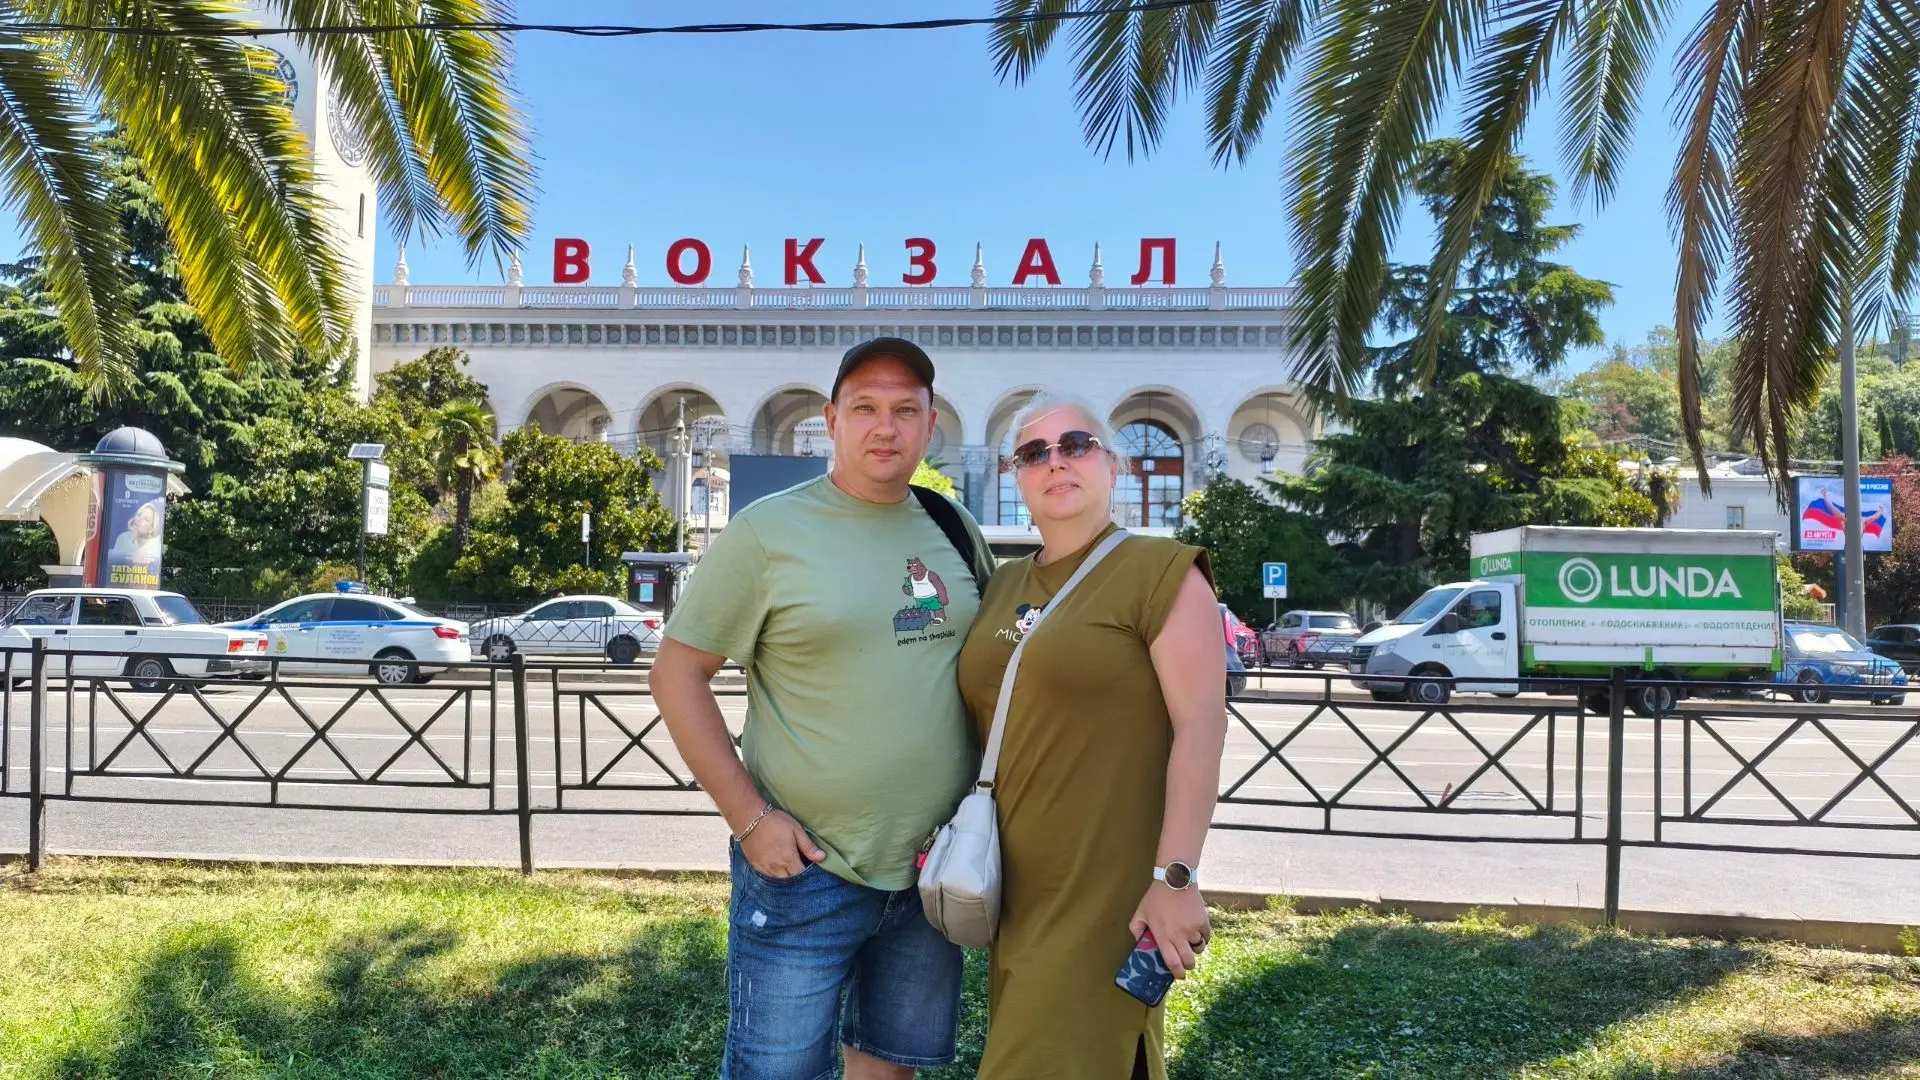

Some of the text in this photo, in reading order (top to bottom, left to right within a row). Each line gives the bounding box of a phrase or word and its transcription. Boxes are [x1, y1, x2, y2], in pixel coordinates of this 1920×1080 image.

[553, 237, 1176, 285] ВОКЗАЛ
[111, 564, 148, 574] ТАТЬЯНА
[1488, 558, 1513, 572] LUNDA
[1269, 565, 1282, 584] P
[1610, 565, 1743, 598] LUNDA
[1529, 618, 1586, 628] ОТОПЛЕНИЕ
[897, 636, 917, 647] edem
[994, 628, 1023, 643] MIC
